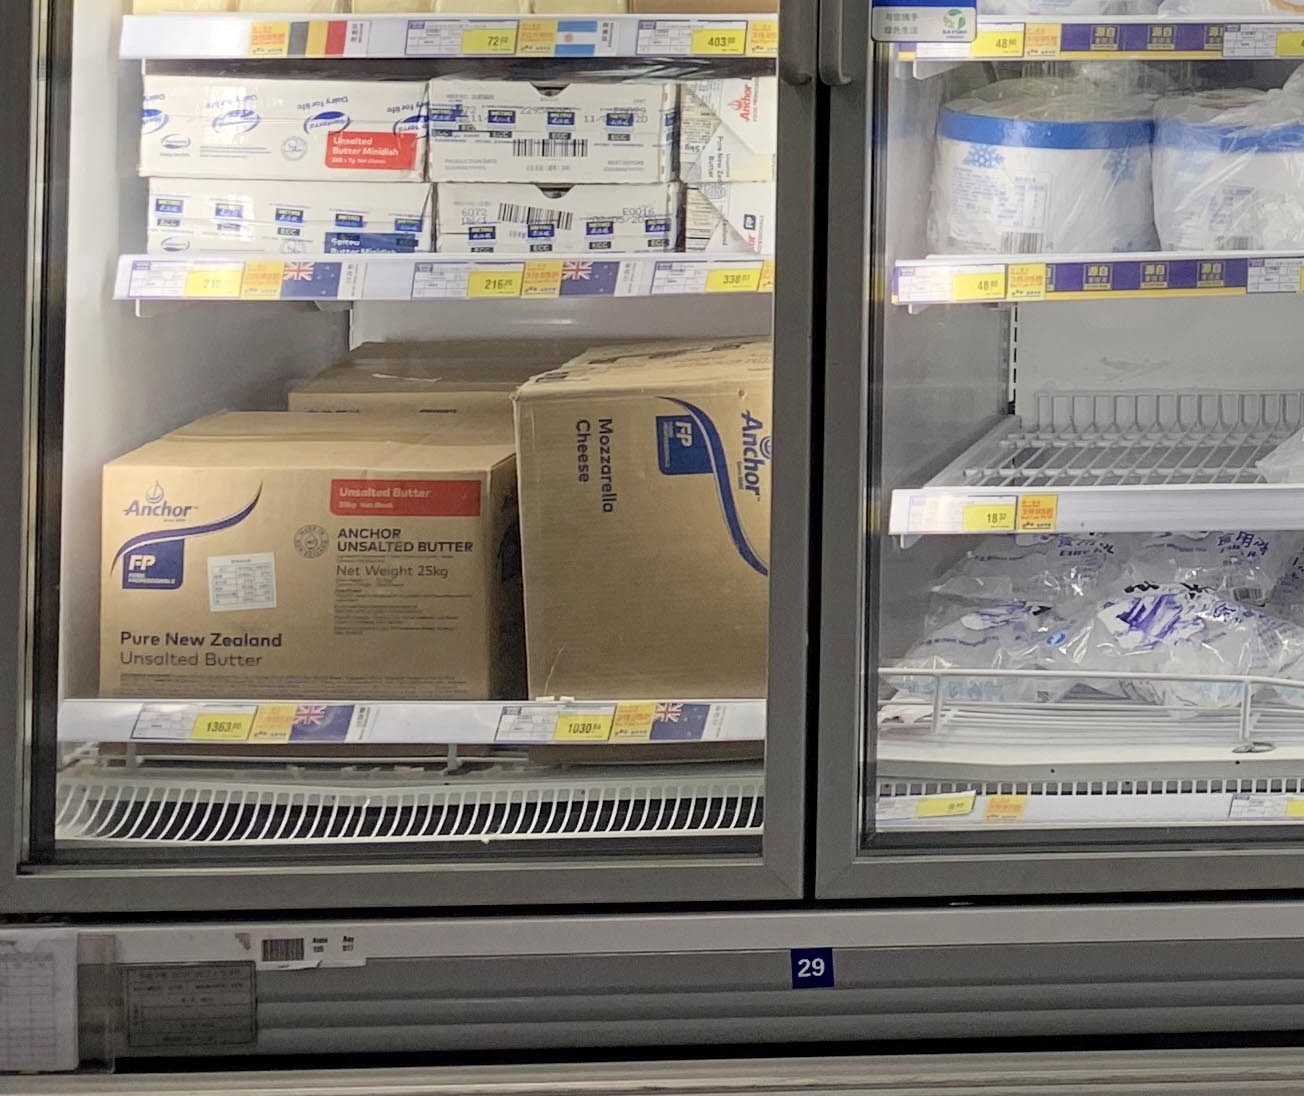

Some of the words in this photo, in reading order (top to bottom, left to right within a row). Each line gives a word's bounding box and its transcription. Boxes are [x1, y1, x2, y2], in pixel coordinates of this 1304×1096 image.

[741, 84, 752, 121] Anchor
[576, 419, 590, 483] Cheese
[741, 409, 760, 495] Anchor
[599, 418, 618, 513] Mozzarella
[339, 488, 390, 497] Unsalted
[392, 489, 431, 498] Butter
[124, 499, 192, 517] Anchor
[338, 529, 401, 539] ANCHOR
[338, 540, 414, 553] UNSALTED
[418, 541, 473, 553] BUTTER
[337, 566, 360, 577] Net
[364, 565, 413, 579] Weight
[418, 566, 448, 579] 25kg
[121, 632, 160, 646] Pure
[165, 633, 204, 646] New
[211, 633, 282, 648] Zealand
[121, 652, 198, 666] Unsalted
[205, 653, 262, 666] Butter
[798, 959, 825, 977] 29
